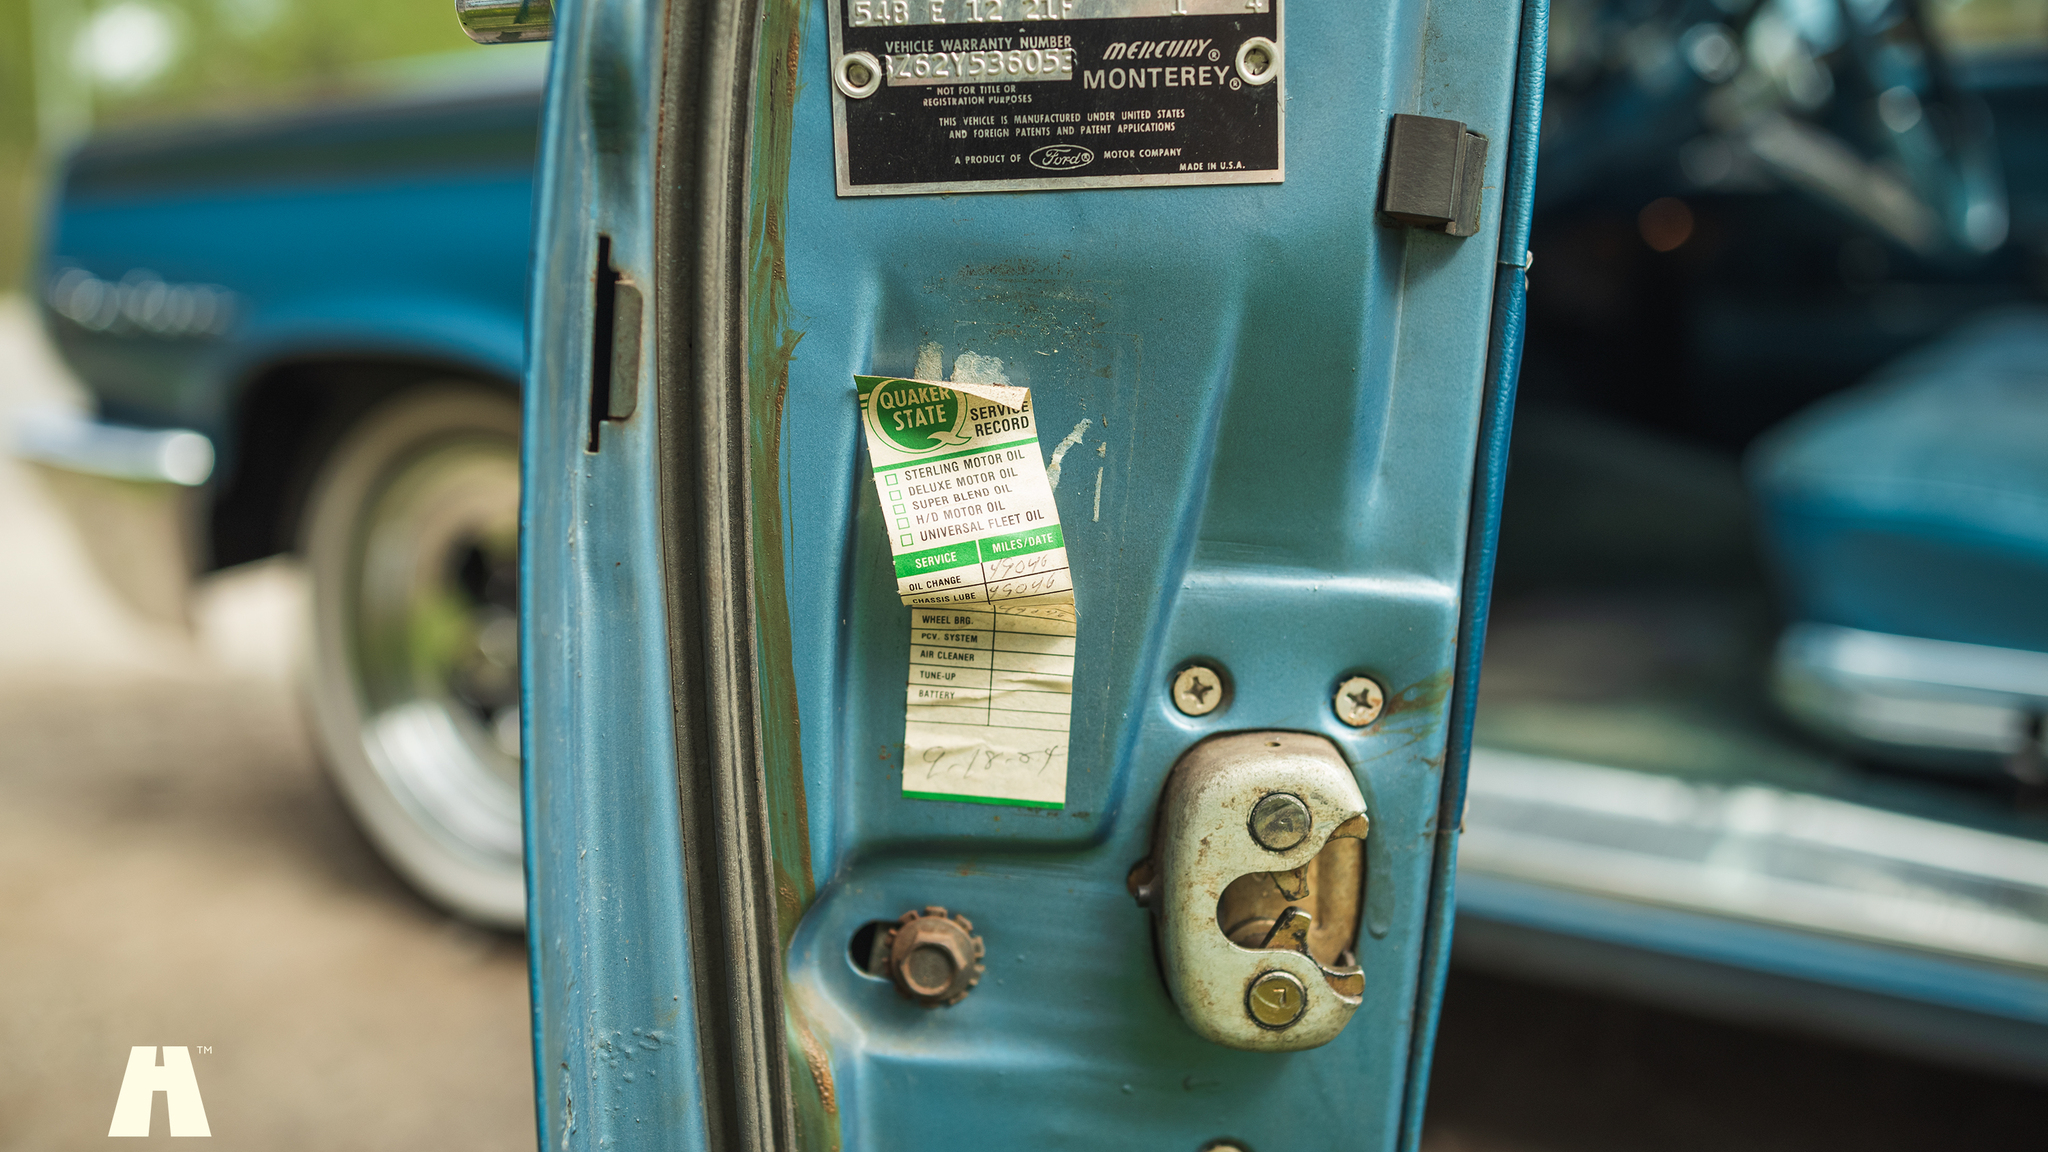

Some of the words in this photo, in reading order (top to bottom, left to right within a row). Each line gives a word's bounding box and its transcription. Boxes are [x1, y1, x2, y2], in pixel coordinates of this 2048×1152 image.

[928, 0, 946, 25] E
[966, 0, 1003, 23] 12
[885, 40, 934, 53] VEHICLE
[940, 37, 1013, 52] WARRANTY
[1020, 35, 1072, 50] NUMBER
[936, 86, 954, 96] NOT
[958, 86, 976, 95] FOR
[980, 85, 1000, 94] TITLE
[1004, 84, 1016, 94] OR
[922, 96, 985, 107] REGISTRATION
[988, 94, 1032, 104] PURPOSES
[939, 117, 957, 127] THIS
[963, 115, 995, 126] VEHICLE
[1001, 115, 1008, 125] IS
[1014, 113, 1081, 124] MANUFACTURED
[1087, 111, 1115, 122] UNDER
[1121, 110, 1151, 121] UNITED
[1157, 109, 1185, 120] STATES
[949, 129, 968, 139] AND
[974, 128, 1010, 139] FOREIGN
[1015, 126, 1050, 137] PATENTS
[1056, 125, 1075, 136] AND
[1080, 124, 1112, 135] PATENT
[1117, 122, 1176, 134] APPLICATIONS
[954, 156, 961, 164] A
[965, 154, 1005, 164] PRODUCT
[1010, 154, 1021, 163] OF
[1103, 150, 1135, 159] MOTOR
[1139, 148, 1182, 158] COMPANY
[1179, 162, 1203, 171] MADE
[1207, 162, 1217, 170] IN
[1220, 160, 1246, 170] U.S.A.
[880, 386, 951, 409] QUAKER
[893, 404, 947, 431] STATE
[974, 416, 1029, 437] RECORD
[904, 461, 960, 481] STERLING
[964, 453, 1004, 470] MOTOR
[1006, 449, 1026, 462] OIL
[908, 479, 953, 496] DELUXE
[956, 470, 996, 487] MOTOR
[999, 467, 1018, 479] OIL
[912, 496, 949, 510] SUPER
[953, 488, 990, 503] BLEND
[994, 484, 1013, 496] OIL
[916, 511, 939, 525] H/D
[944, 504, 983, 519] MOTOR
[986, 500, 1006, 513] OIL
[920, 520, 984, 542] UNIVERSAL
[988, 512, 1022, 530] FLEET
[1025, 508, 1045, 522] OIL
[992, 532, 1054, 554] MILES/DATE
[914, 551, 958, 569] SERVICE
[908, 583, 924, 592] OIL
[926, 576, 962, 589] CHANGE
[912, 596, 950, 604] CHASSIS
[953, 592, 976, 602] LUBE
[922, 615, 951, 625] WHEEL
[954, 616, 974, 625] BRG.
[921, 632, 940, 640] PCV.
[944, 633, 978, 643] SYSTEM
[920, 650, 934, 659] AIR
[937, 651, 975, 662] CLEANER
[920, 670, 956, 681] TUNE-UP
[918, 690, 955, 700] BATTERY
